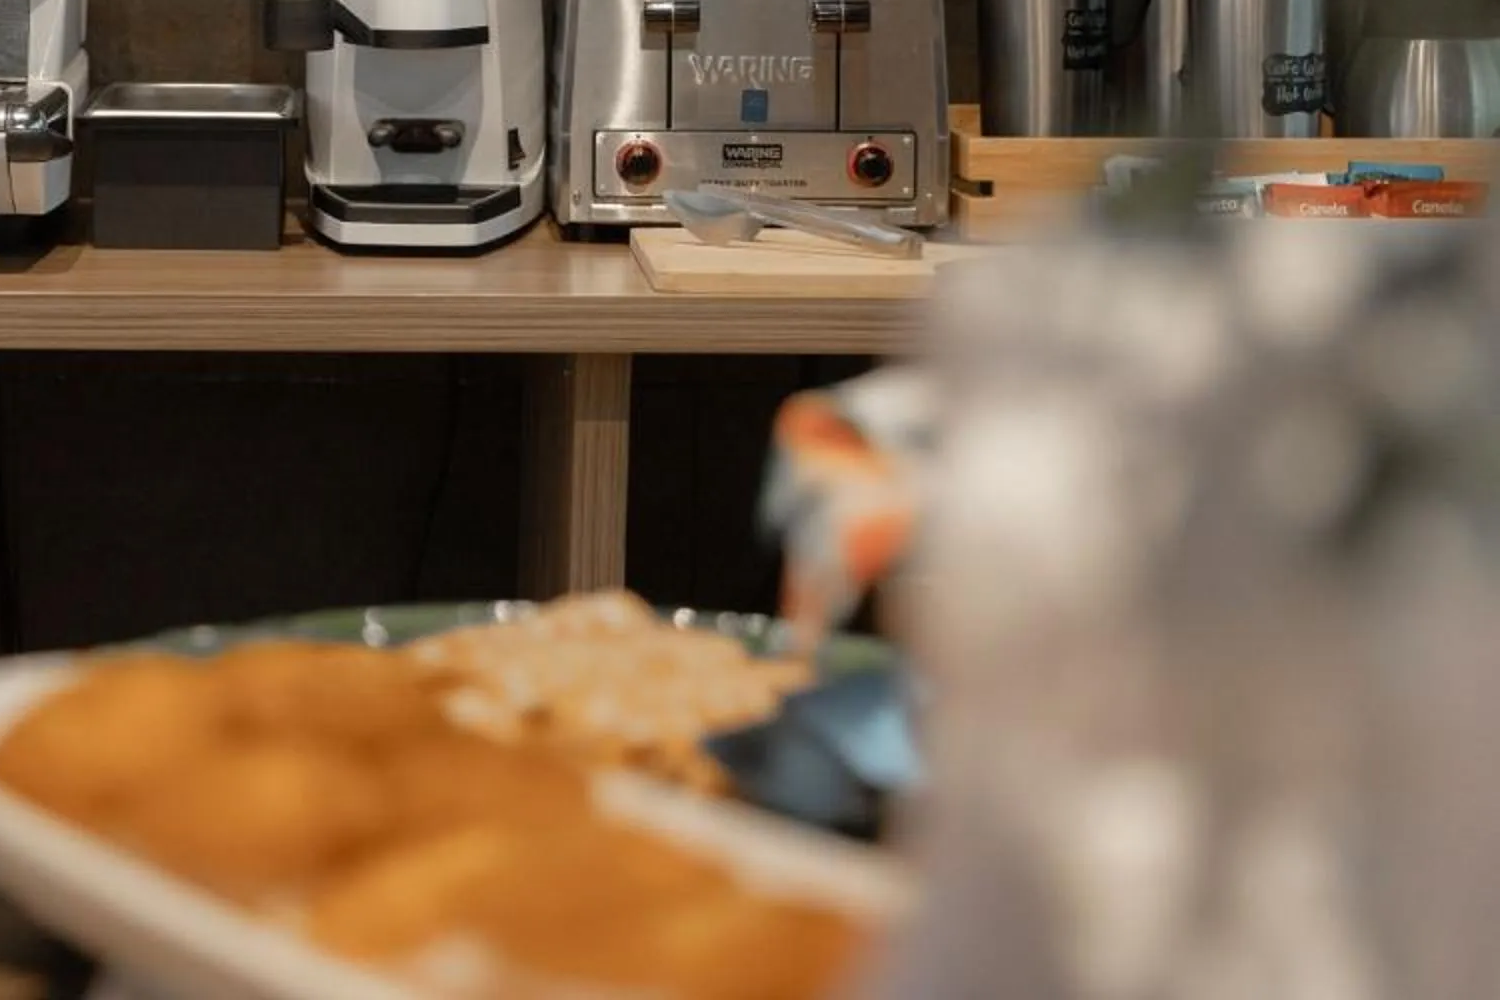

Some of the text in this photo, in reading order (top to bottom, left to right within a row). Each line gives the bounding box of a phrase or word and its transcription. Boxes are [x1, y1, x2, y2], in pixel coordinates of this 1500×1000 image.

[688, 53, 814, 88] WARING
[725, 146, 781, 161] WARING
[1299, 201, 1349, 216] Canela
[1412, 199, 1465, 214] Canela
